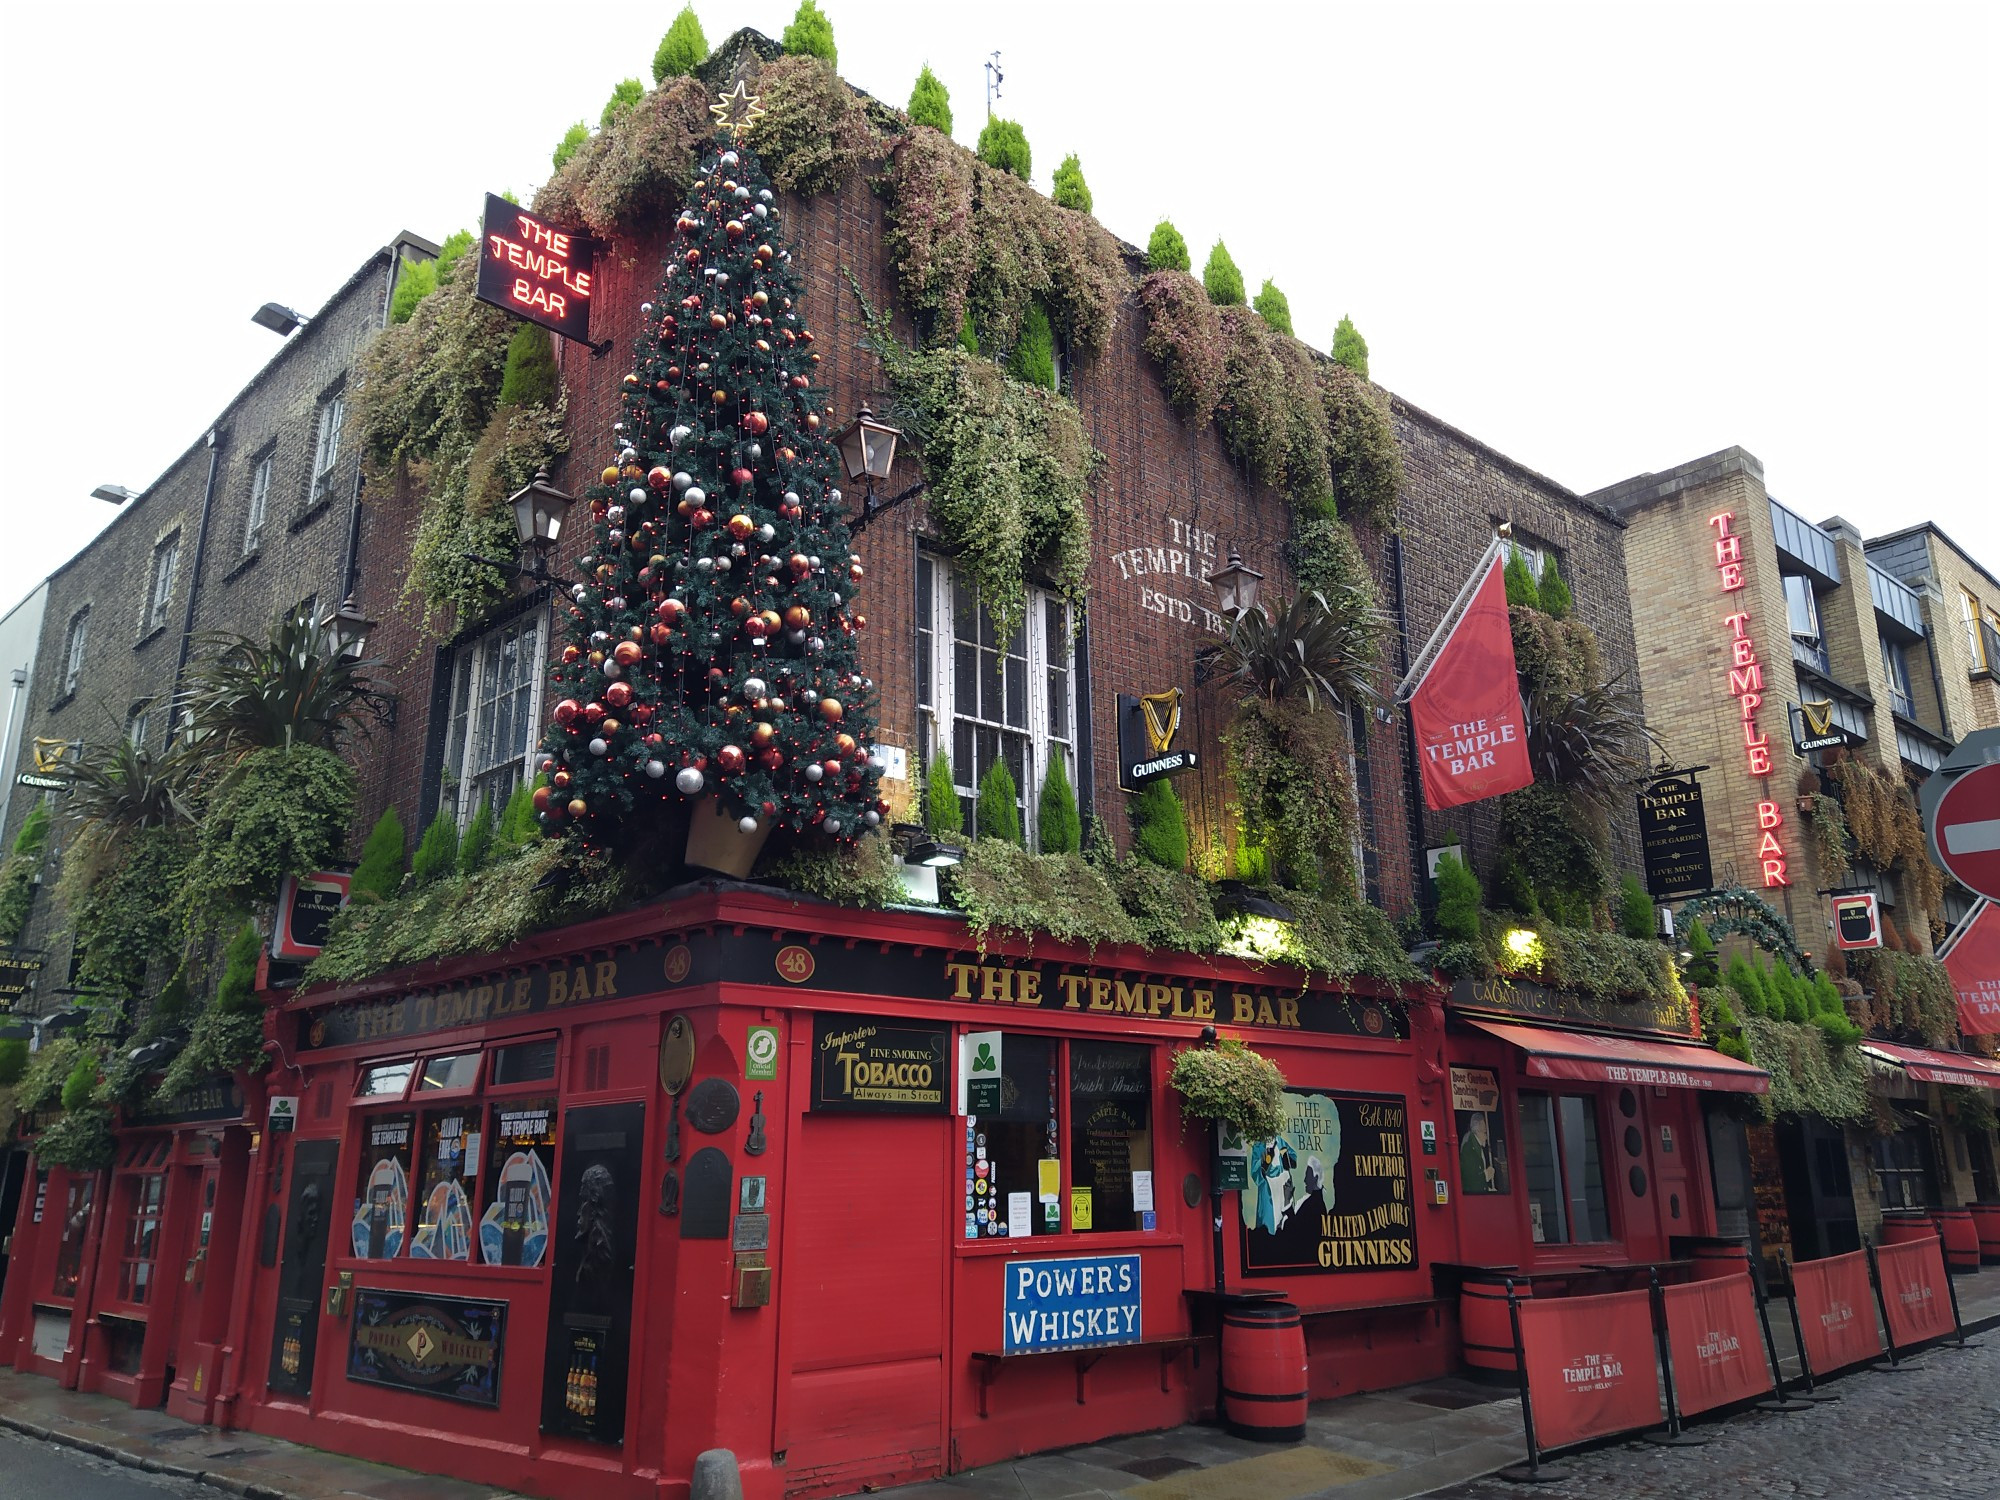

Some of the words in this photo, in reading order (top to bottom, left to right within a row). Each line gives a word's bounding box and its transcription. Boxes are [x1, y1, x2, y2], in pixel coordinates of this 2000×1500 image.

[517, 215, 570, 258] THE
[489, 235, 591, 297] TEMPLE
[512, 278, 566, 319] BAR
[1169, 517, 1217, 559] THE
[1710, 511, 1745, 592] THE
[1111, 547, 1215, 587] TEMPLE
[1725, 611, 1773, 779] TEMPLE
[1450, 719, 1487, 739] THE
[1426, 724, 1516, 763] TEMPLE
[1801, 736, 1841, 750] GUINNESS
[1132, 754, 1183, 778] GUINNESS
[1451, 750, 1496, 776] BAR
[1658, 784, 1679, 794] THE
[1641, 791, 1700, 809] TEMPLE
[1655, 807, 1687, 820] BAR
[1647, 838, 1668, 848] BEER
[1669, 833, 1702, 844] GARDEN
[1757, 800, 1790, 889] BAR
[1652, 867, 1673, 876] LIVE
[1674, 863, 1704, 874] MUSIC
[1665, 874, 1693, 884] DAILY
[298, 902, 336, 912] GUINNESS
[784, 952, 806, 973] 48
[356, 1003, 408, 1039] THE
[415, 978, 532, 1028] TEMPLE
[546, 960, 619, 1006] BAR
[945, 963, 1043, 1005] THE
[1058, 974, 1217, 1020] TEMPLE
[1231, 993, 1301, 1027] BAR
[1959, 991, 2000, 1004] TEM
[820, 1026, 877, 1065] Importers
[855, 1041, 866, 1049] OF
[870, 1048, 891, 1058] FINE
[891, 1049, 932, 1060] SMOKING
[836, 1052, 933, 1095] TOBACCO
[1452, 1070, 1466, 1084] Beer
[1467, 1072, 1489, 1085] Garden
[1605, 1066, 1628, 1081] THE
[1628, 1067, 1669, 1084] TEMPLE
[1669, 1071, 1689, 1086] BAR
[1930, 1070, 1944, 1081] THE
[1943, 1071, 1965, 1084] TEMPLE
[1964, 1074, 1975, 1086] BAR
[201, 1088, 224, 1110] BAR
[855, 1088, 892, 1100] Always
[897, 1091, 907, 1099] in
[910, 1090, 939, 1101] Stock
[1453, 1083, 1479, 1099] Smoking
[1295, 1101, 1321, 1118] THE
[1459, 1097, 1474, 1109] Area
[500, 1121, 512, 1137] THE
[512, 1119, 535, 1136] TEMPLE
[533, 1118, 547, 1135] BAR
[1087, 1107, 1119, 1127] TEMPLE
[1121, 1111, 1137, 1128] BAR
[1286, 1118, 1333, 1136] TEMPLE
[1384, 1108, 1402, 1128] 1840
[371, 1131, 381, 1146] THE
[380, 1130, 397, 1145] TEMPLE
[396, 1129, 408, 1144] BAR
[1297, 1135, 1323, 1152] BAR
[1379, 1132, 1403, 1155] THE
[1354, 1155, 1406, 1178] EMPEROR
[1393, 1179, 1406, 1201] OF
[1320, 1213, 1368, 1239] MALTED
[1367, 1202, 1410, 1233] LIQUORS
[1317, 1238, 1413, 1268] GUINNESS
[1016, 1264, 1132, 1300] POWER'S
[1008, 1305, 1138, 1345] WHISKEY
[1722, 1336, 1740, 1350] BAR
[1584, 1354, 1601, 1366] THE
[1562, 1366, 1602, 1384] TEMPLE
[1602, 1361, 1624, 1378] BAR
